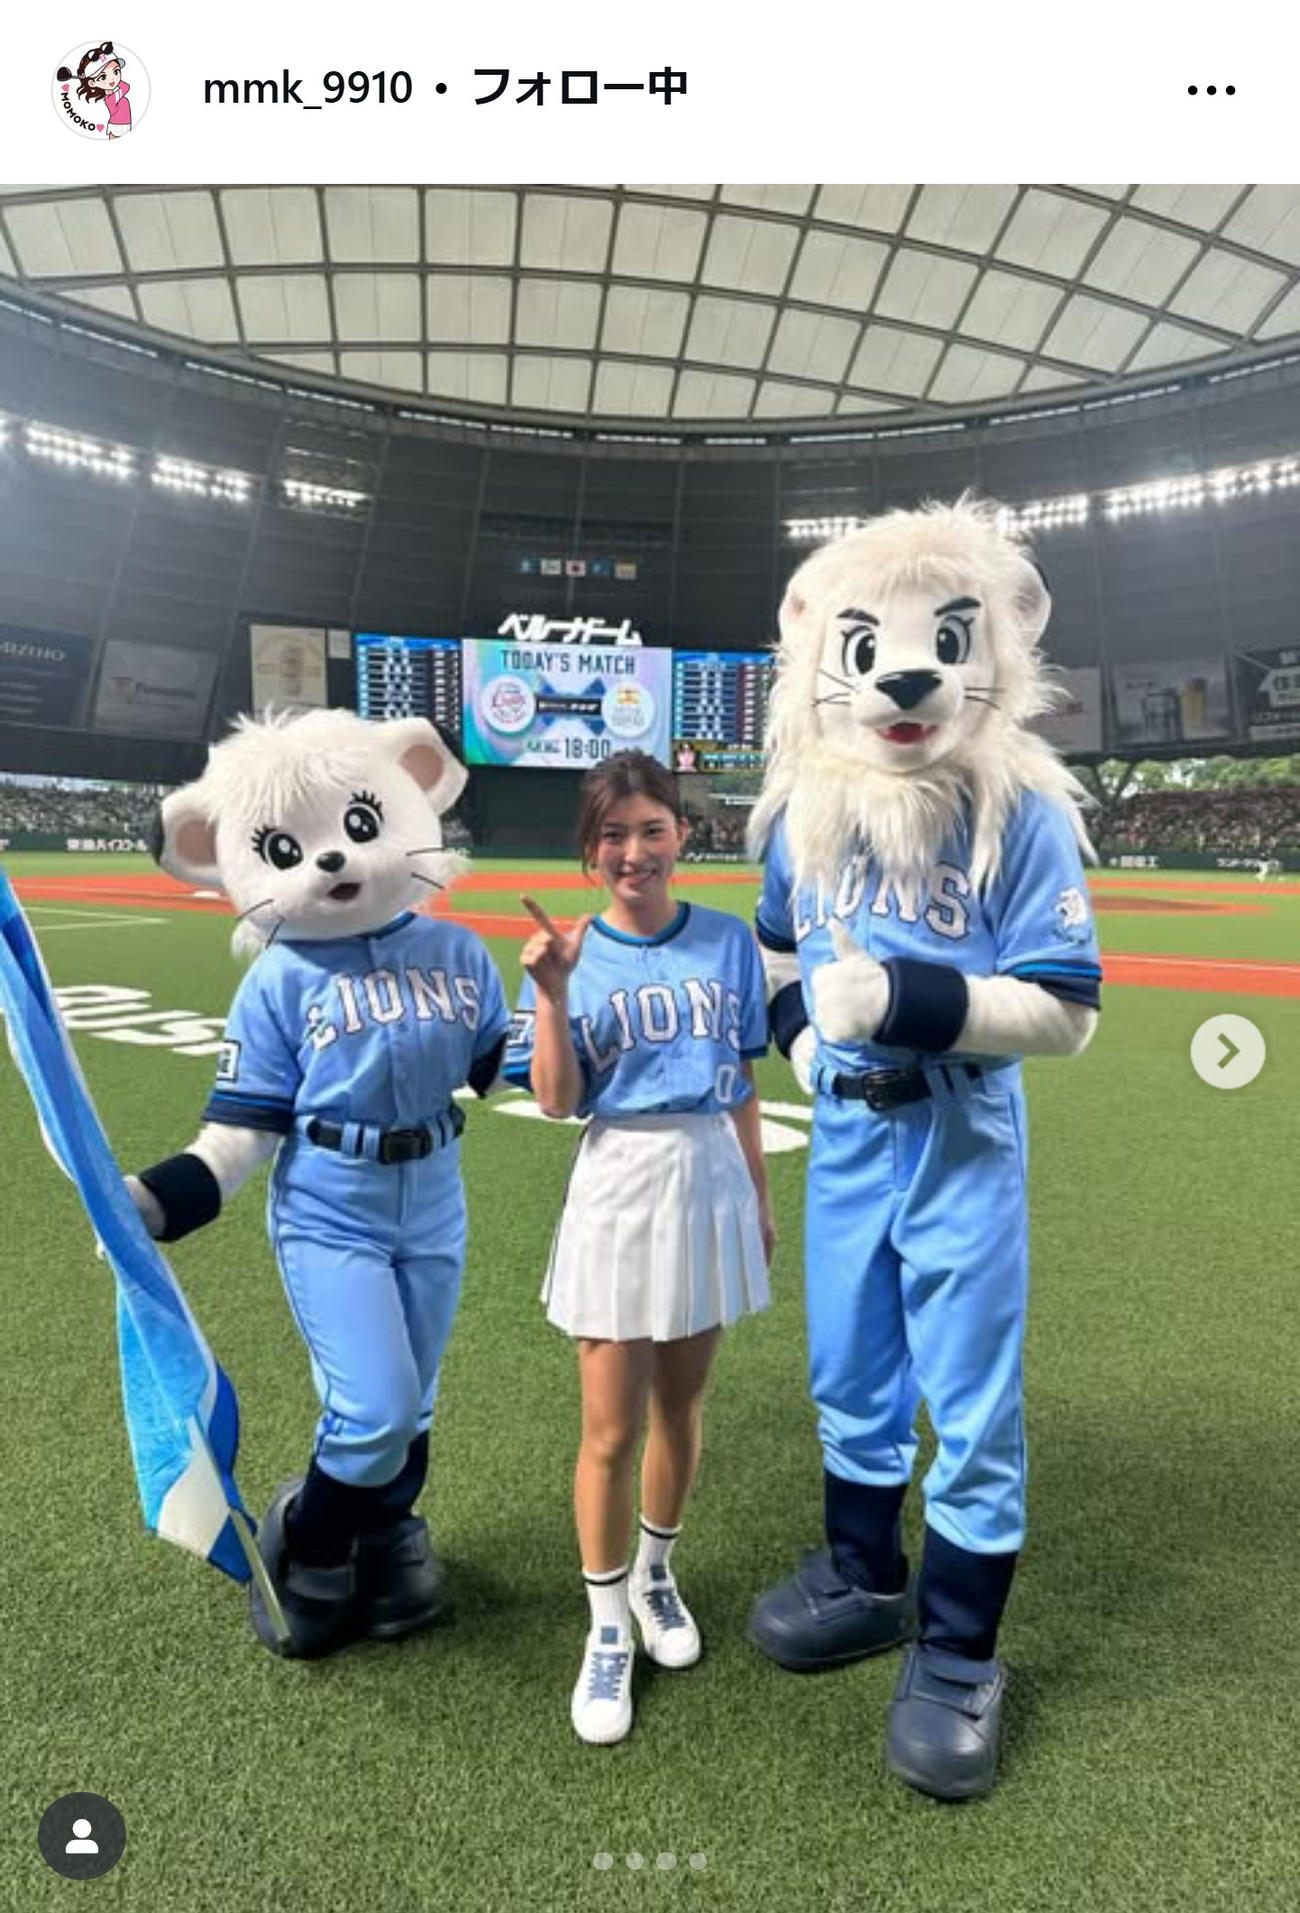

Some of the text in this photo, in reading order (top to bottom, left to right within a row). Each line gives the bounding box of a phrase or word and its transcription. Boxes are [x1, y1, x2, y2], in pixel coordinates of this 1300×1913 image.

[501, 650, 635, 674] TODAY'S MATCH
[565, 738, 610, 760] 18:00
[305, 966, 481, 1051] LIONS
